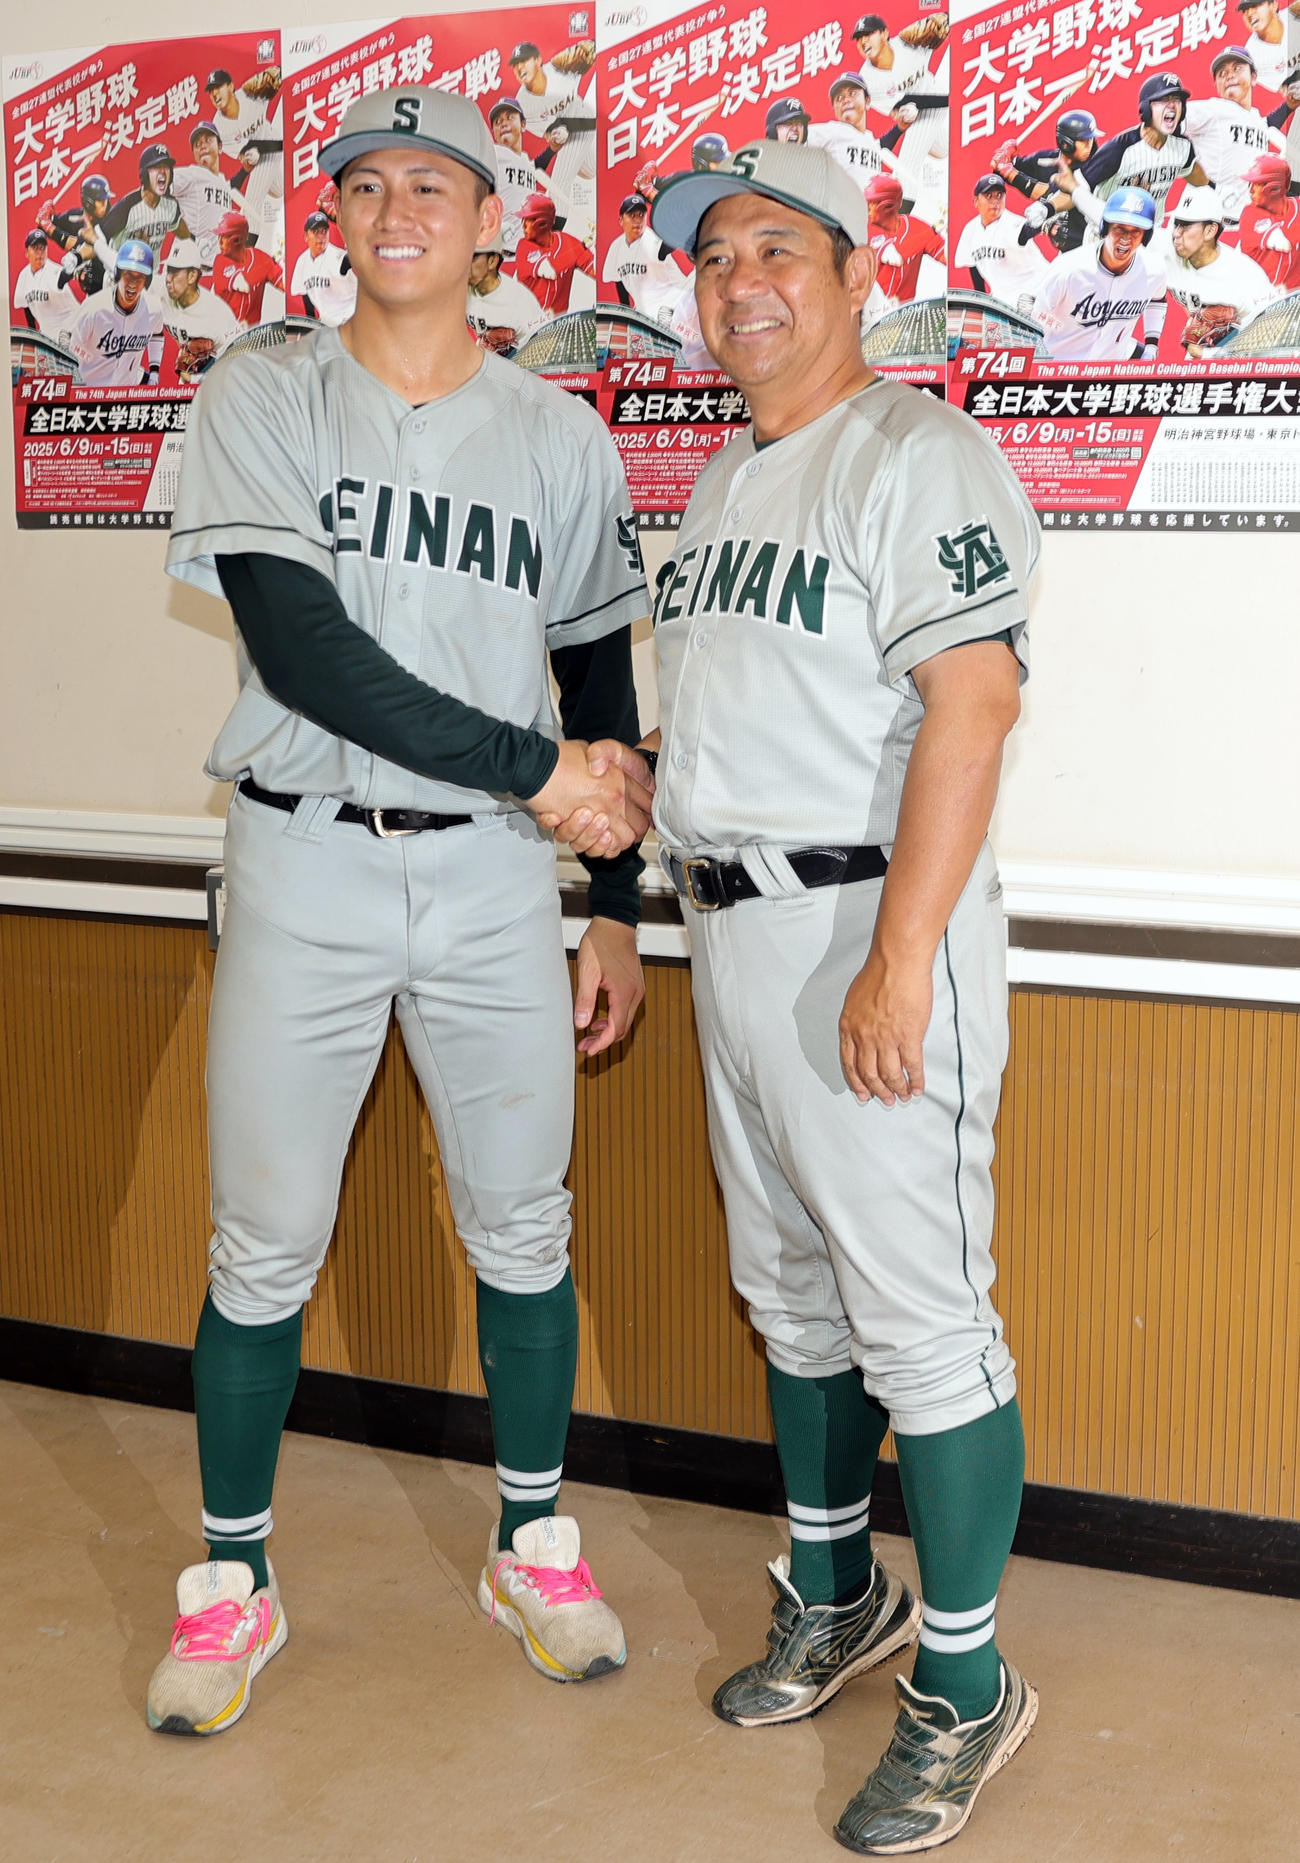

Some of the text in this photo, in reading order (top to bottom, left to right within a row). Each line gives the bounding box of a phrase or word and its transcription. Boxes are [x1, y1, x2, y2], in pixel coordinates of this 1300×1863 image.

[608, 6, 769, 122] 大学野球
[962, 0, 1144, 98] 大学野球
[961, 0, 1229, 147] 日本一決定戦
[607, 19, 844, 169] 日本一決定戦
[13, 62, 139, 165] 大学野球
[392, 96, 423, 134] S
[14, 75, 200, 207] 日本一決定戦
[731, 148, 763, 180] S
[608, 361, 666, 387] 第74回
[677, 374, 693, 385] The
[694, 374, 714, 385] 74th
[960, 351, 1026, 379] 第74回
[1037, 365, 1055, 376] The
[1057, 365, 1079, 376] 74th
[1081, 364, 1111, 378] Japan
[1113, 363, 1155, 376] National
[1156, 362, 1206, 377] Collegiate
[1208, 361, 1252, 375] Baseball
[21, 378, 68, 401] 第74回
[75, 387, 194, 400] The 74th Japan National Collegiate
[971, 381, 1300, 416] 全日本大学野球選手権大
[618, 391, 752, 422] 全日本大学
[50, 513, 172, 525] 読売新聞は大学野球を
